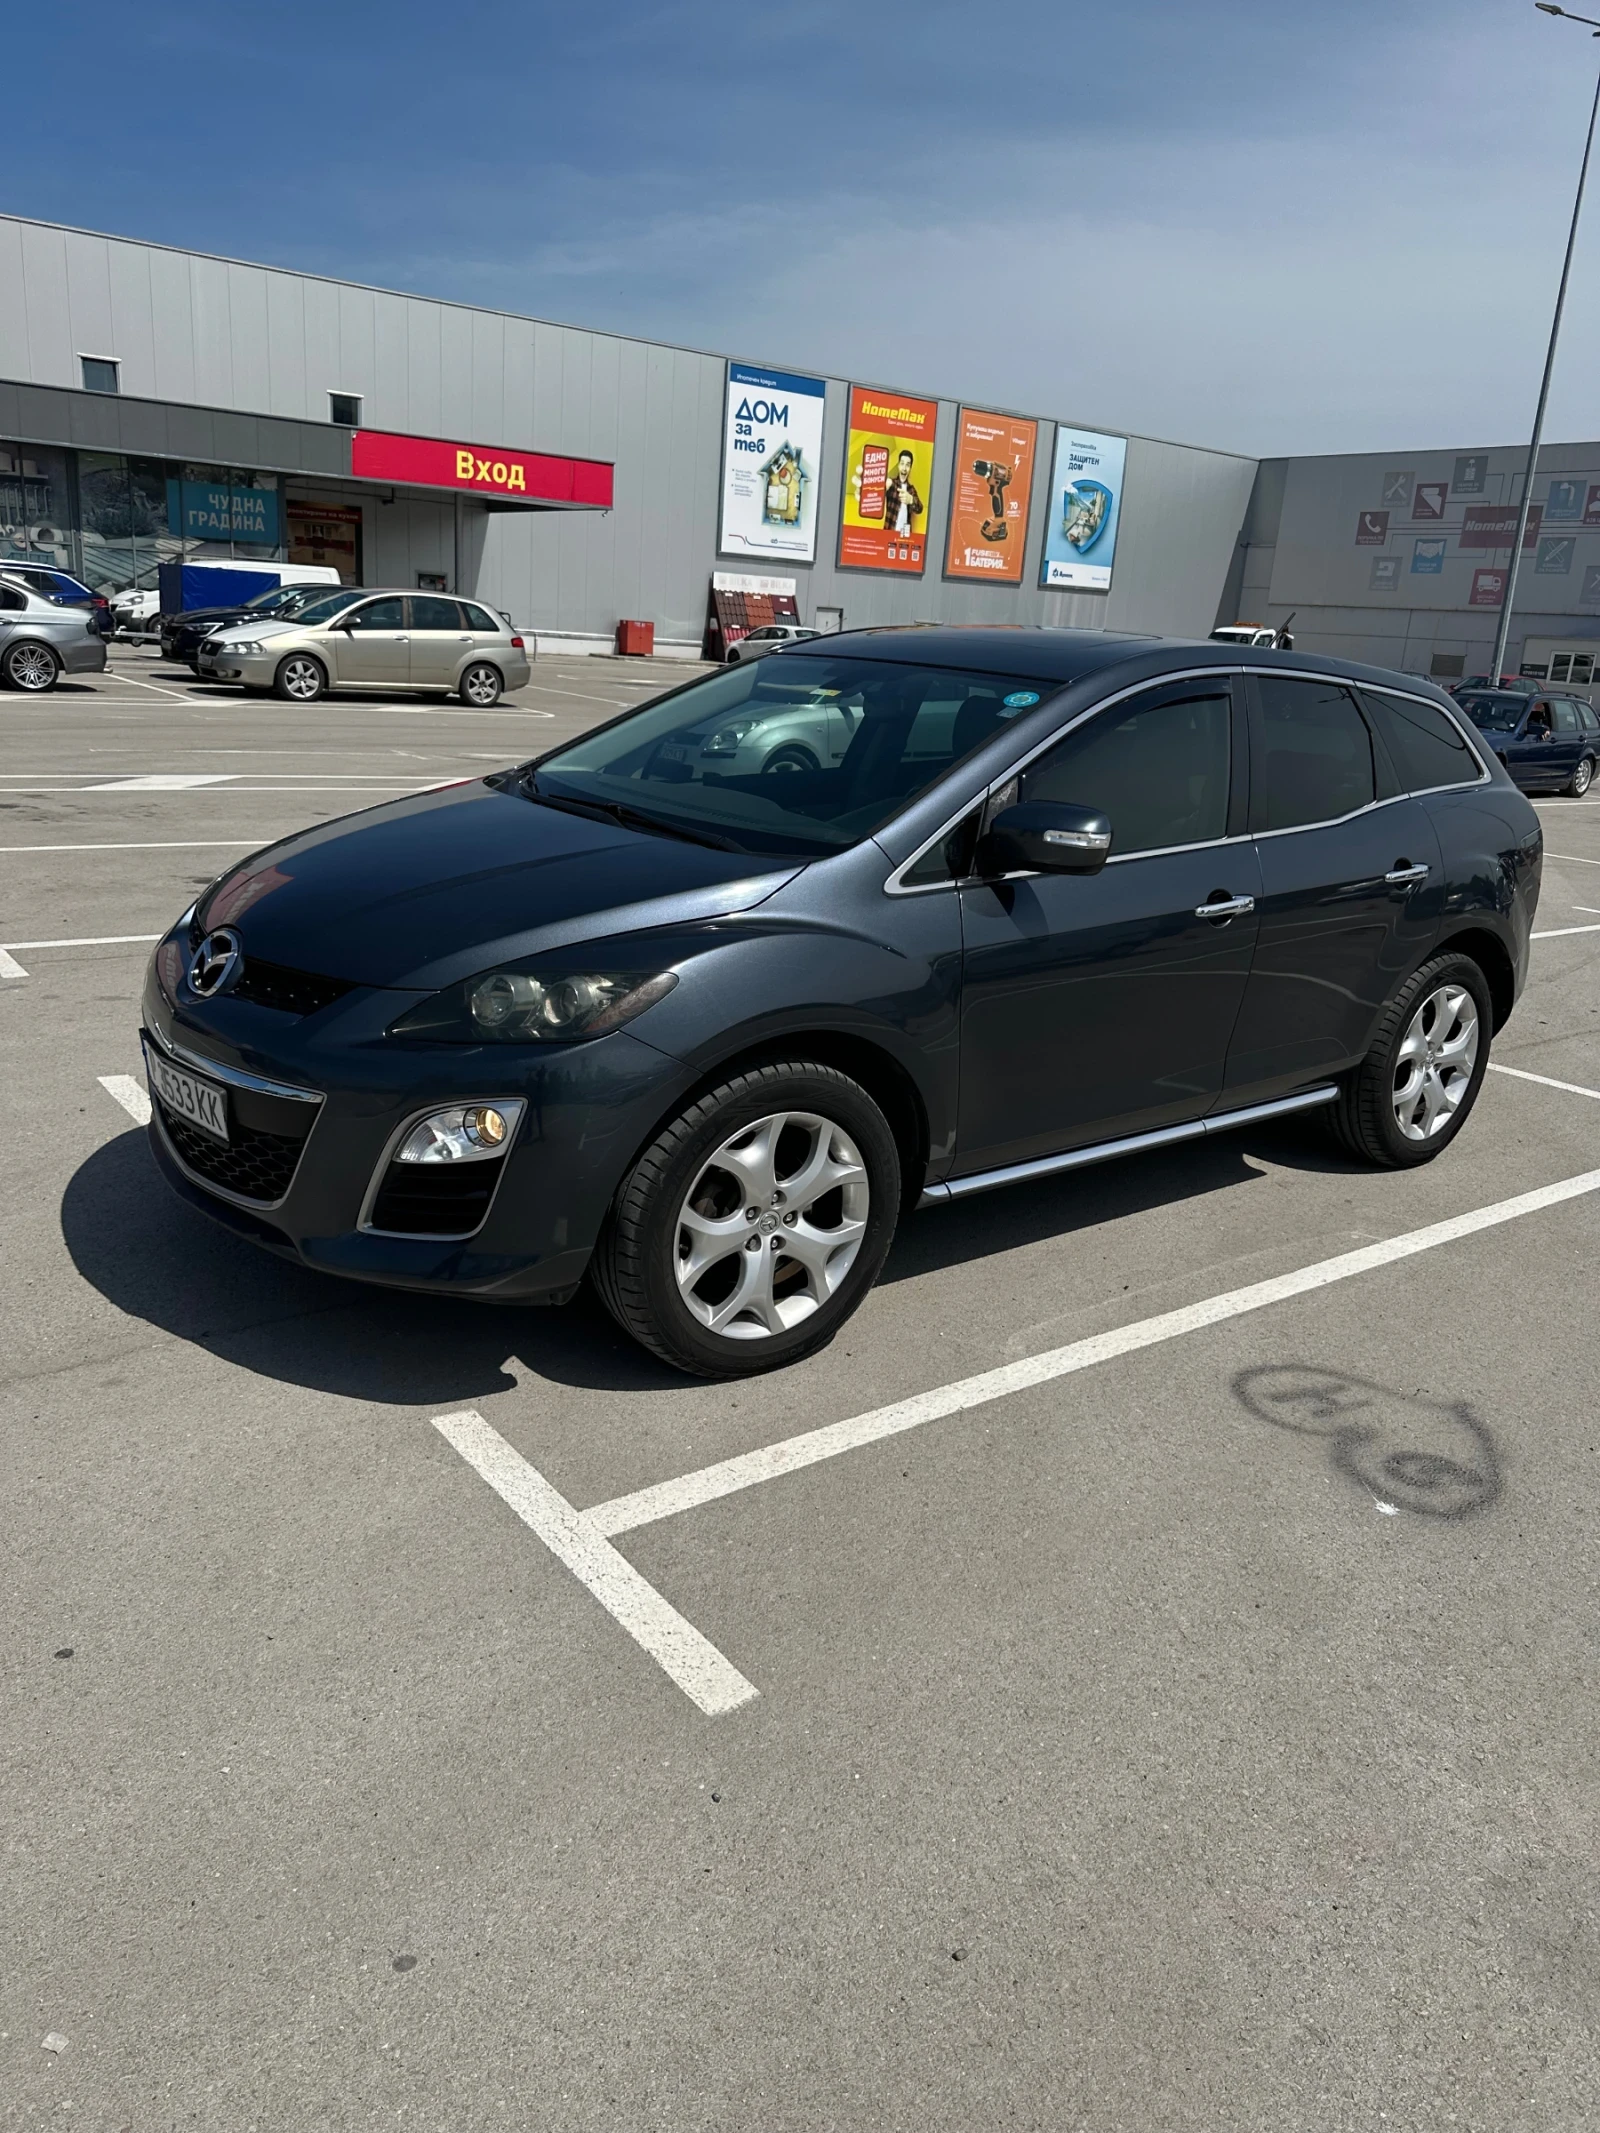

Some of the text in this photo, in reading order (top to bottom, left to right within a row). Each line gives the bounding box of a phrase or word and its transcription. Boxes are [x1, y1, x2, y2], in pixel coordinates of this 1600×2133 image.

[735, 397, 789, 428] ДОМ
[862, 401, 925, 424] HomeMax
[735, 423, 752, 436] за
[734, 438, 765, 454] теб
[865, 452, 887, 463] ЕДНО
[1069, 453, 1100, 466] ЗАЩИТЕН
[456, 450, 526, 491] Вход
[864, 467, 886, 476] МНОГО
[1068, 462, 1084, 471] ДОМ
[208, 493, 265, 514] ЧУДНА
[189, 510, 265, 532] ГРАДИНА
[1465, 520, 1536, 531] HomeMx
[964, 547, 971, 567] 1
